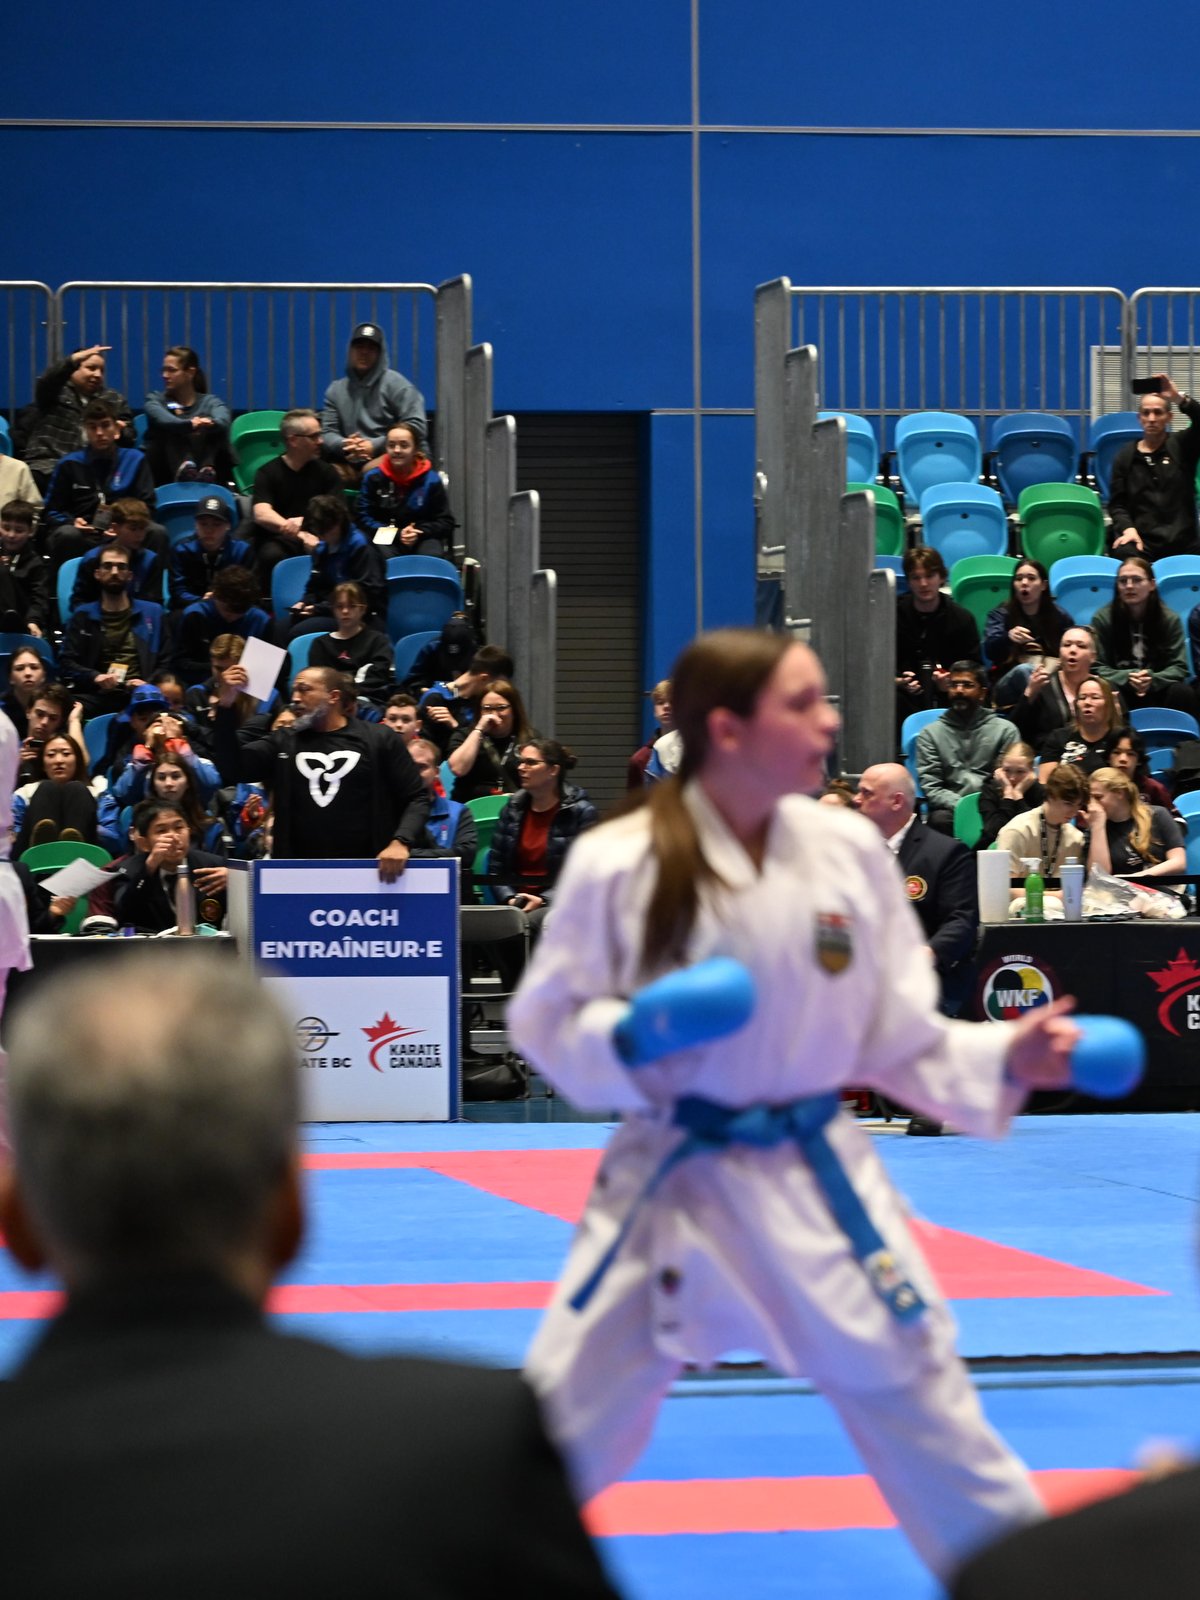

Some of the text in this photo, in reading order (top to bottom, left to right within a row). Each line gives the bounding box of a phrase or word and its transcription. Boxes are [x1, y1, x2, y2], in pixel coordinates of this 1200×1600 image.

[309, 909, 399, 926] COACH
[260, 936, 443, 958] ENTRAÎNEUR·E
[996, 989, 1041, 1007] WKF
[389, 1044, 441, 1056] KARATE
[299, 1057, 352, 1069] ATE BC
[389, 1057, 442, 1069] CANADA
